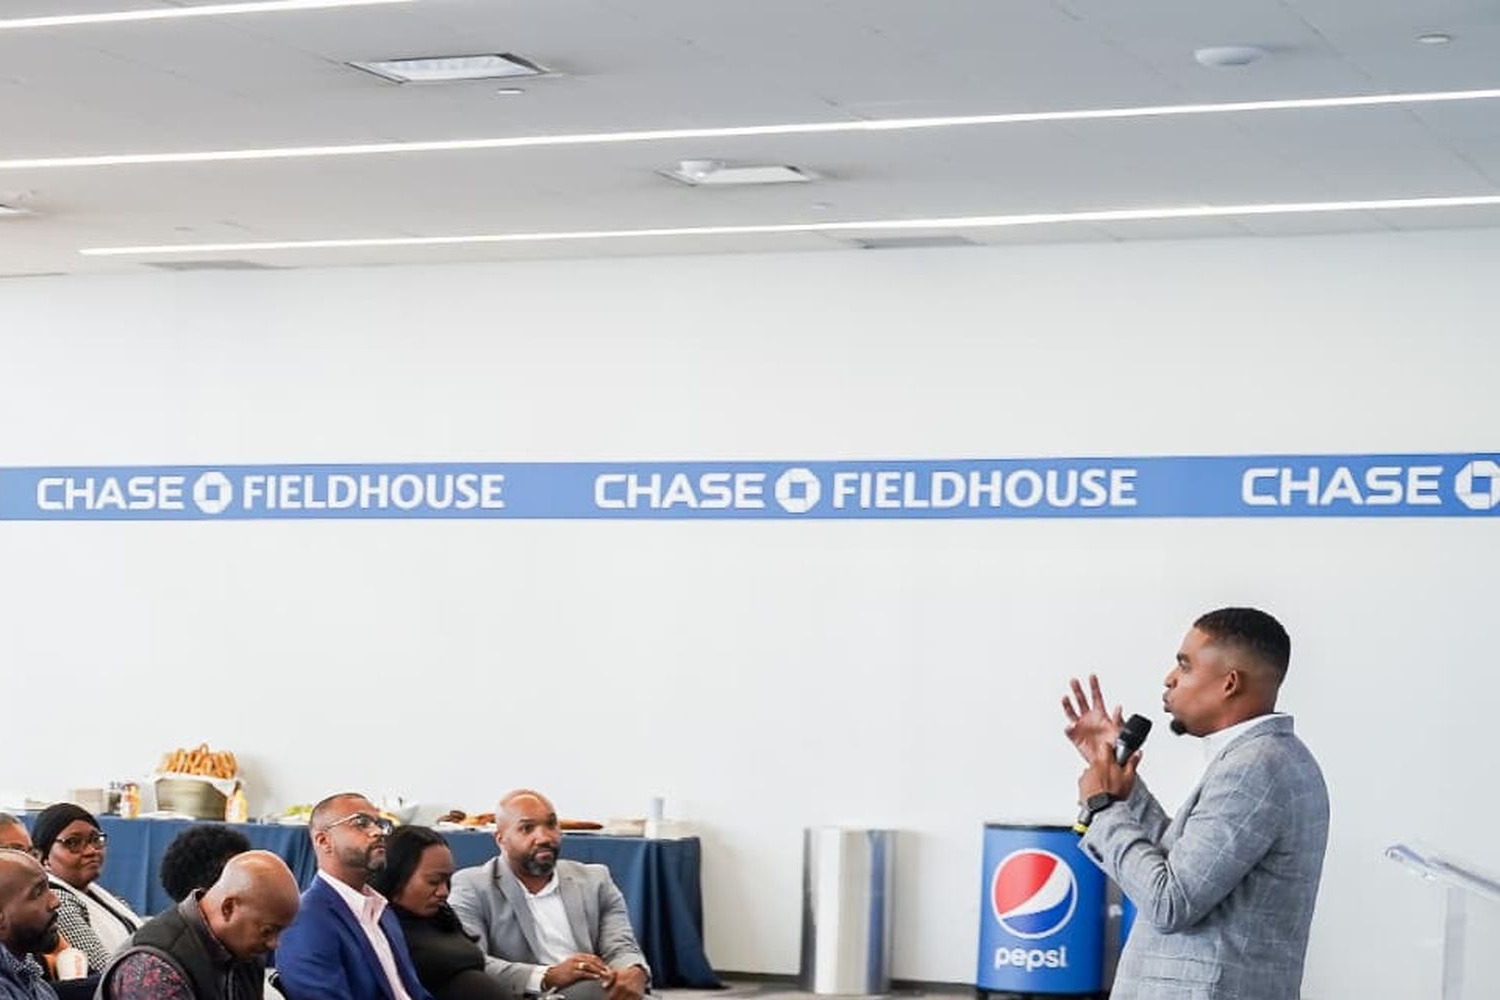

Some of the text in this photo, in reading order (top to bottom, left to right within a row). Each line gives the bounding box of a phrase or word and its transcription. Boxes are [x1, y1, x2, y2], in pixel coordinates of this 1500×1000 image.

[36, 473, 505, 510] CHASE FIELDHOUSE
[594, 468, 1138, 509] CHASE FIELDHOUSE
[1242, 466, 1444, 505] CHASE
[994, 945, 1067, 972] pepsi
